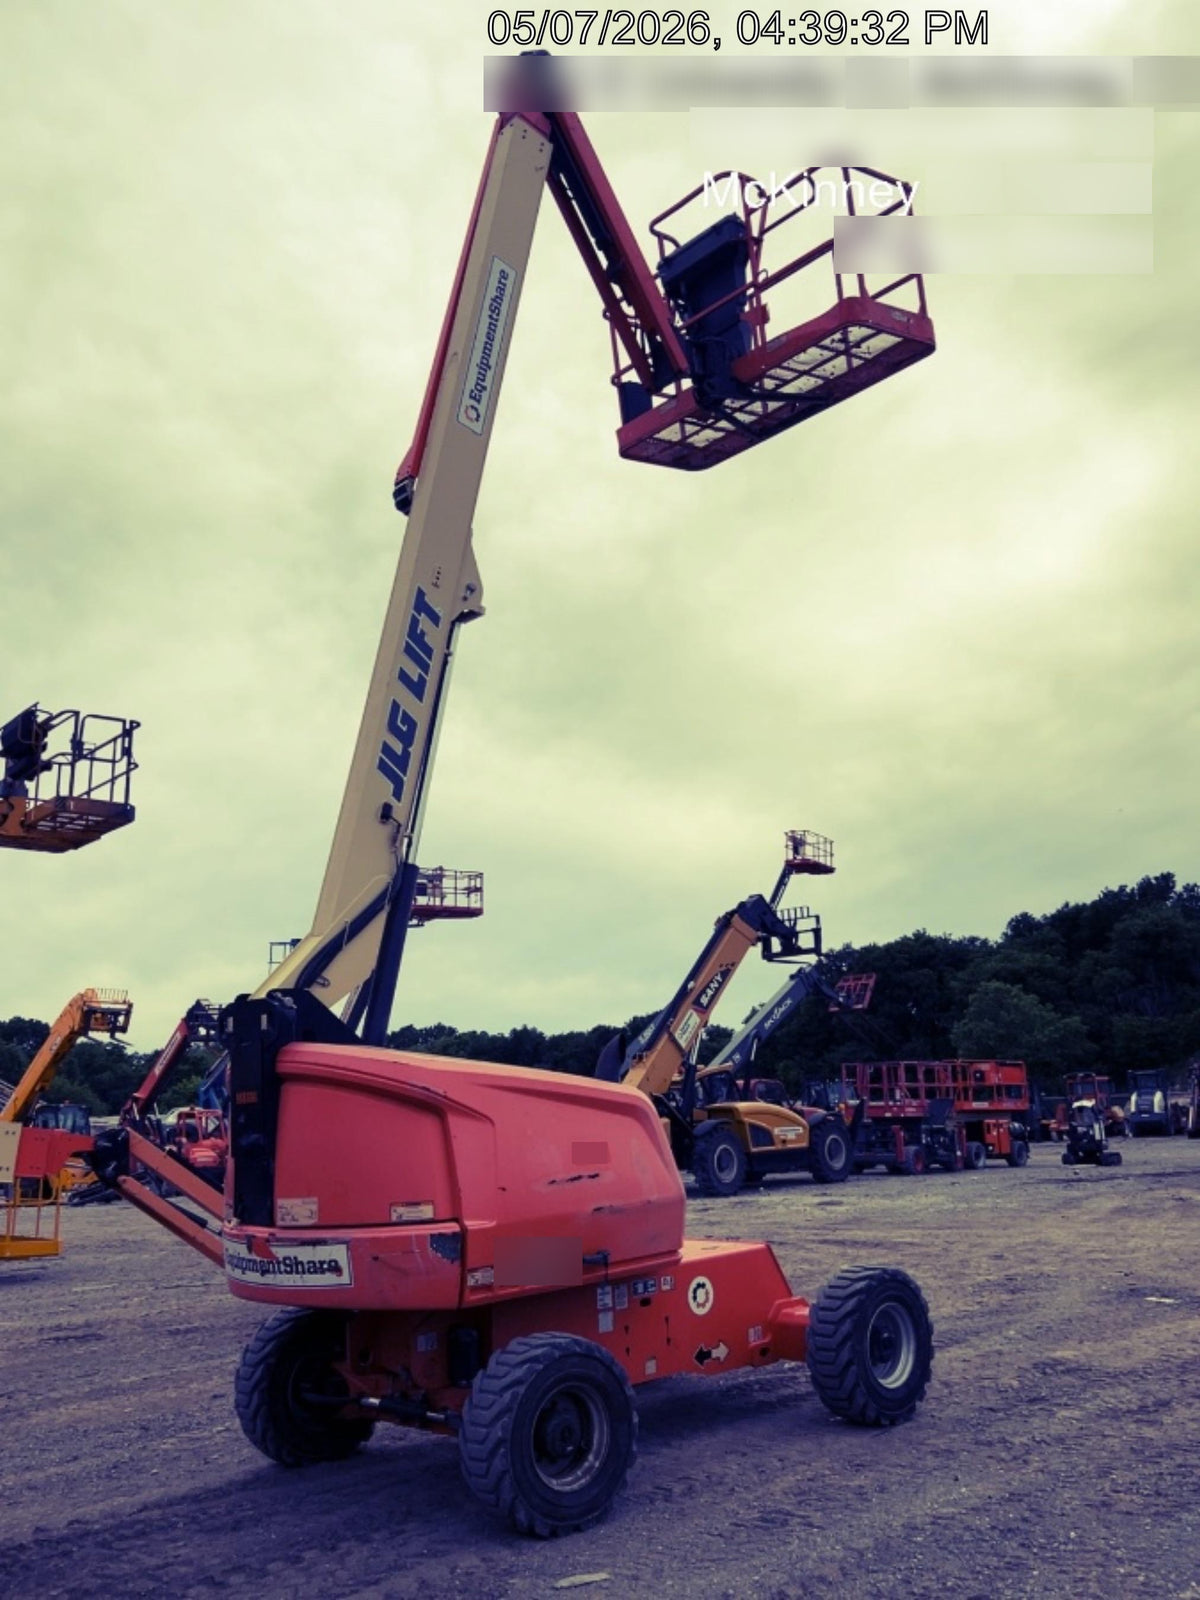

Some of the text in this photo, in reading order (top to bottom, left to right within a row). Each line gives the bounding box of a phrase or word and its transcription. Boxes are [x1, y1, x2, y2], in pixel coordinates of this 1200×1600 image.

[468, 269, 510, 405] EquipmentShare
[376, 585, 442, 803] JLG LIFT
[227, 1254, 343, 1277] quipmentShare
